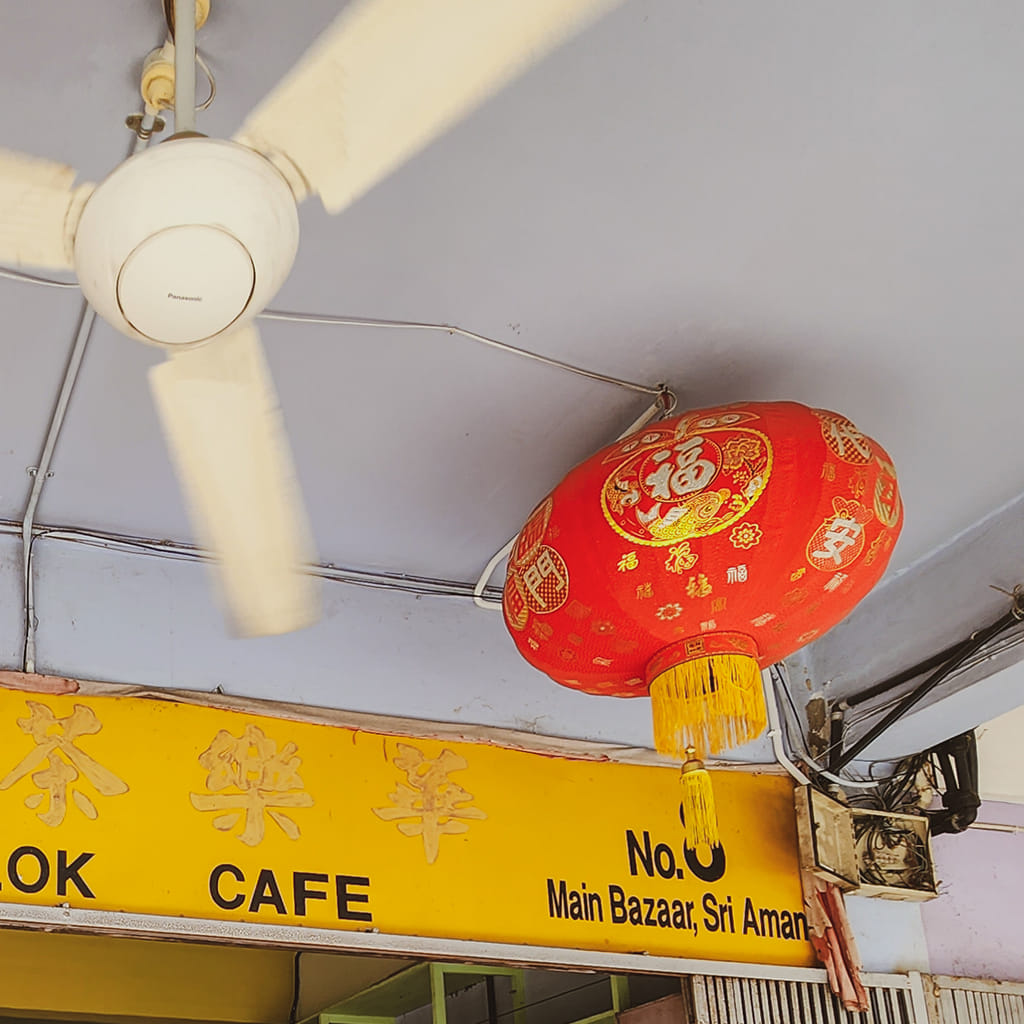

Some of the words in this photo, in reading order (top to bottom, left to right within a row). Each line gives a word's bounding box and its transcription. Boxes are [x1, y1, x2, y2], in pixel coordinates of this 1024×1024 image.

[645, 436, 717, 499] 福
[208, 863, 374, 922] CAFE
[546, 878, 604, 922] Main
[608, 884, 699, 937] Bazaar,
[701, 892, 736, 934] Sri
[742, 897, 810, 941] Aman
